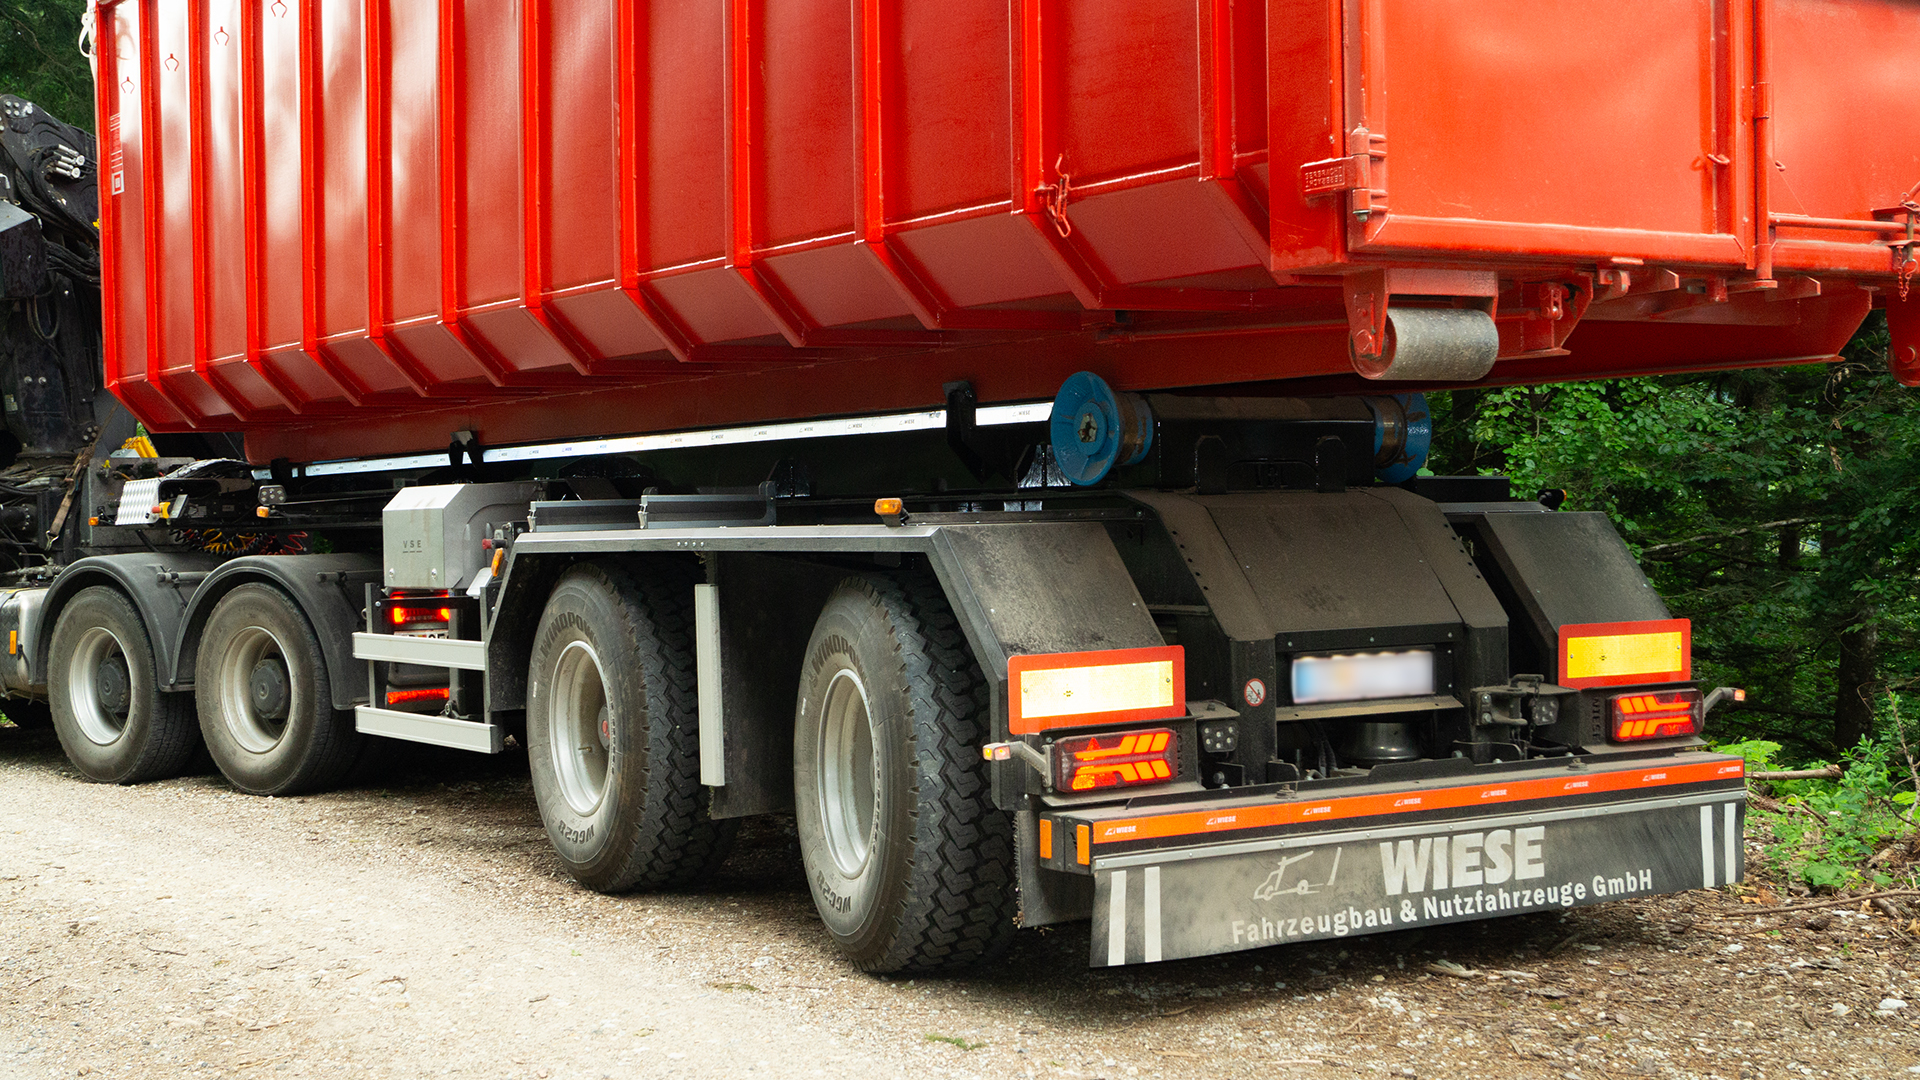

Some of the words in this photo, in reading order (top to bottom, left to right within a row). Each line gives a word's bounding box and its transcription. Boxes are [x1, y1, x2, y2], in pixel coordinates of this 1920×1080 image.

[1490, 789, 1508, 797] WIESE
[1404, 797, 1422, 805] WIESE
[1313, 806, 1331, 814] WIESE
[1217, 815, 1237, 824] WIESE
[1116, 825, 1137, 834] WIESE
[1379, 826, 1545, 896] WIESE
[1232, 906, 1392, 944] Fahrzeugbau
[1400, 899, 1418, 922] &
[1424, 882, 1586, 919] Nutzfahrzeuge
[1592, 869, 1652, 897] GmbH
